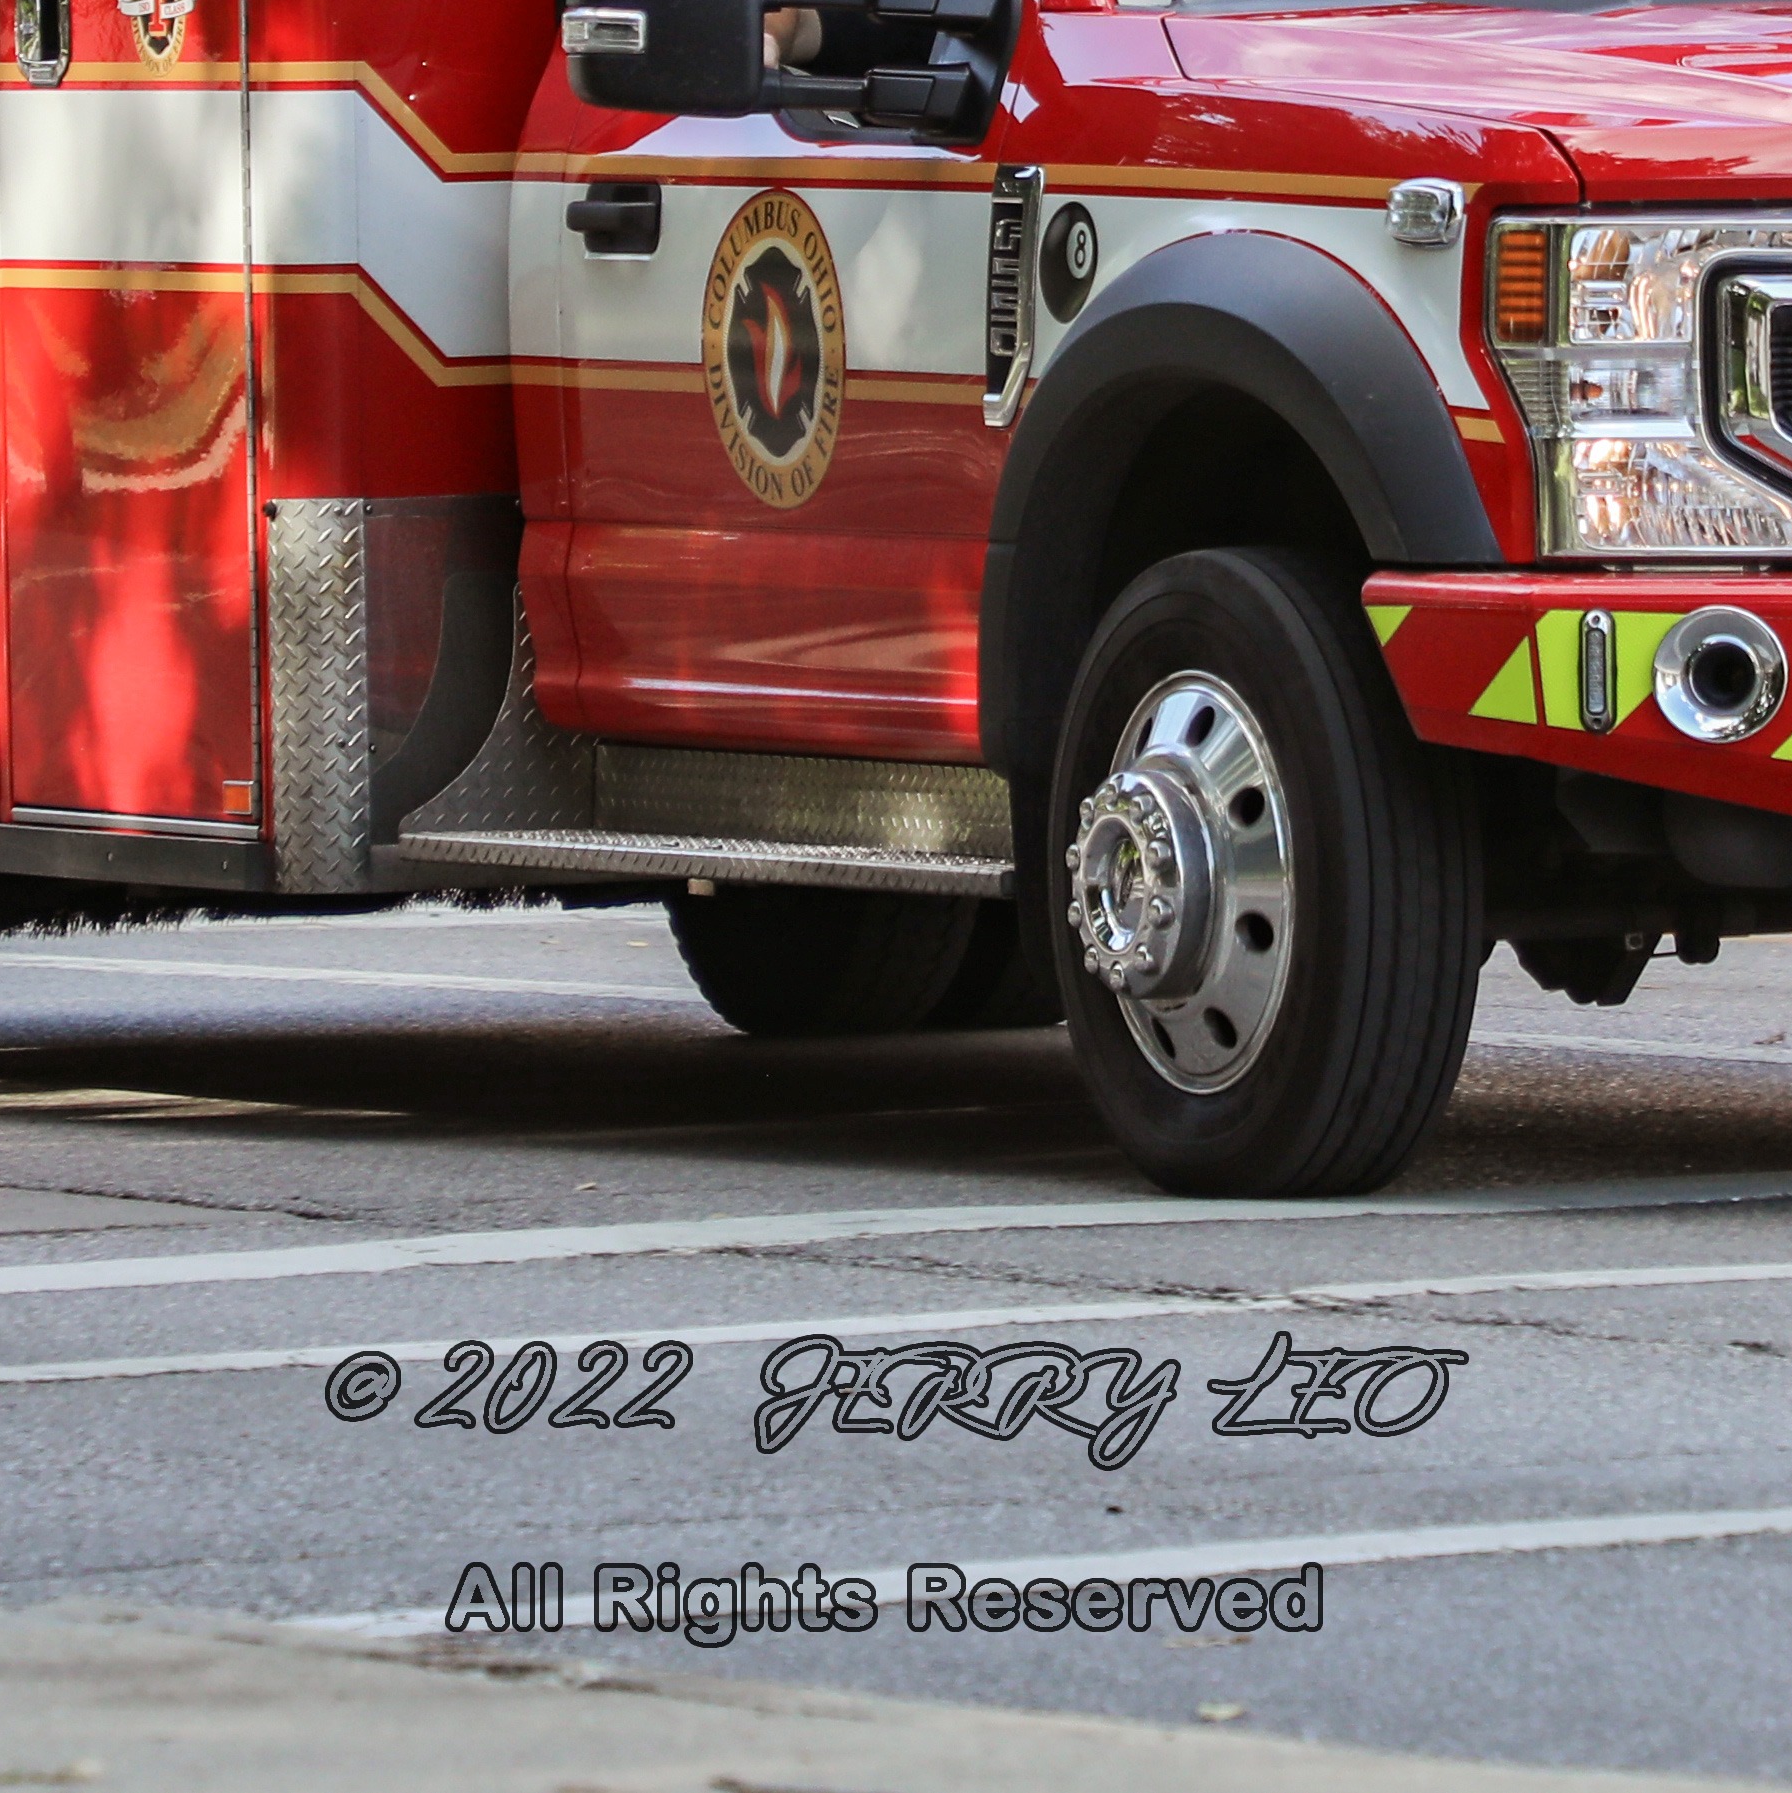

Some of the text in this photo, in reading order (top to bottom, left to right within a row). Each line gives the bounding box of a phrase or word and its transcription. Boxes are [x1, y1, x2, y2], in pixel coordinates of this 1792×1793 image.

[709, 201, 839, 335] COLUMBUS OHIO
[1074, 229, 1087, 269] 8
[709, 364, 842, 502] DIVISION OF FIRE
